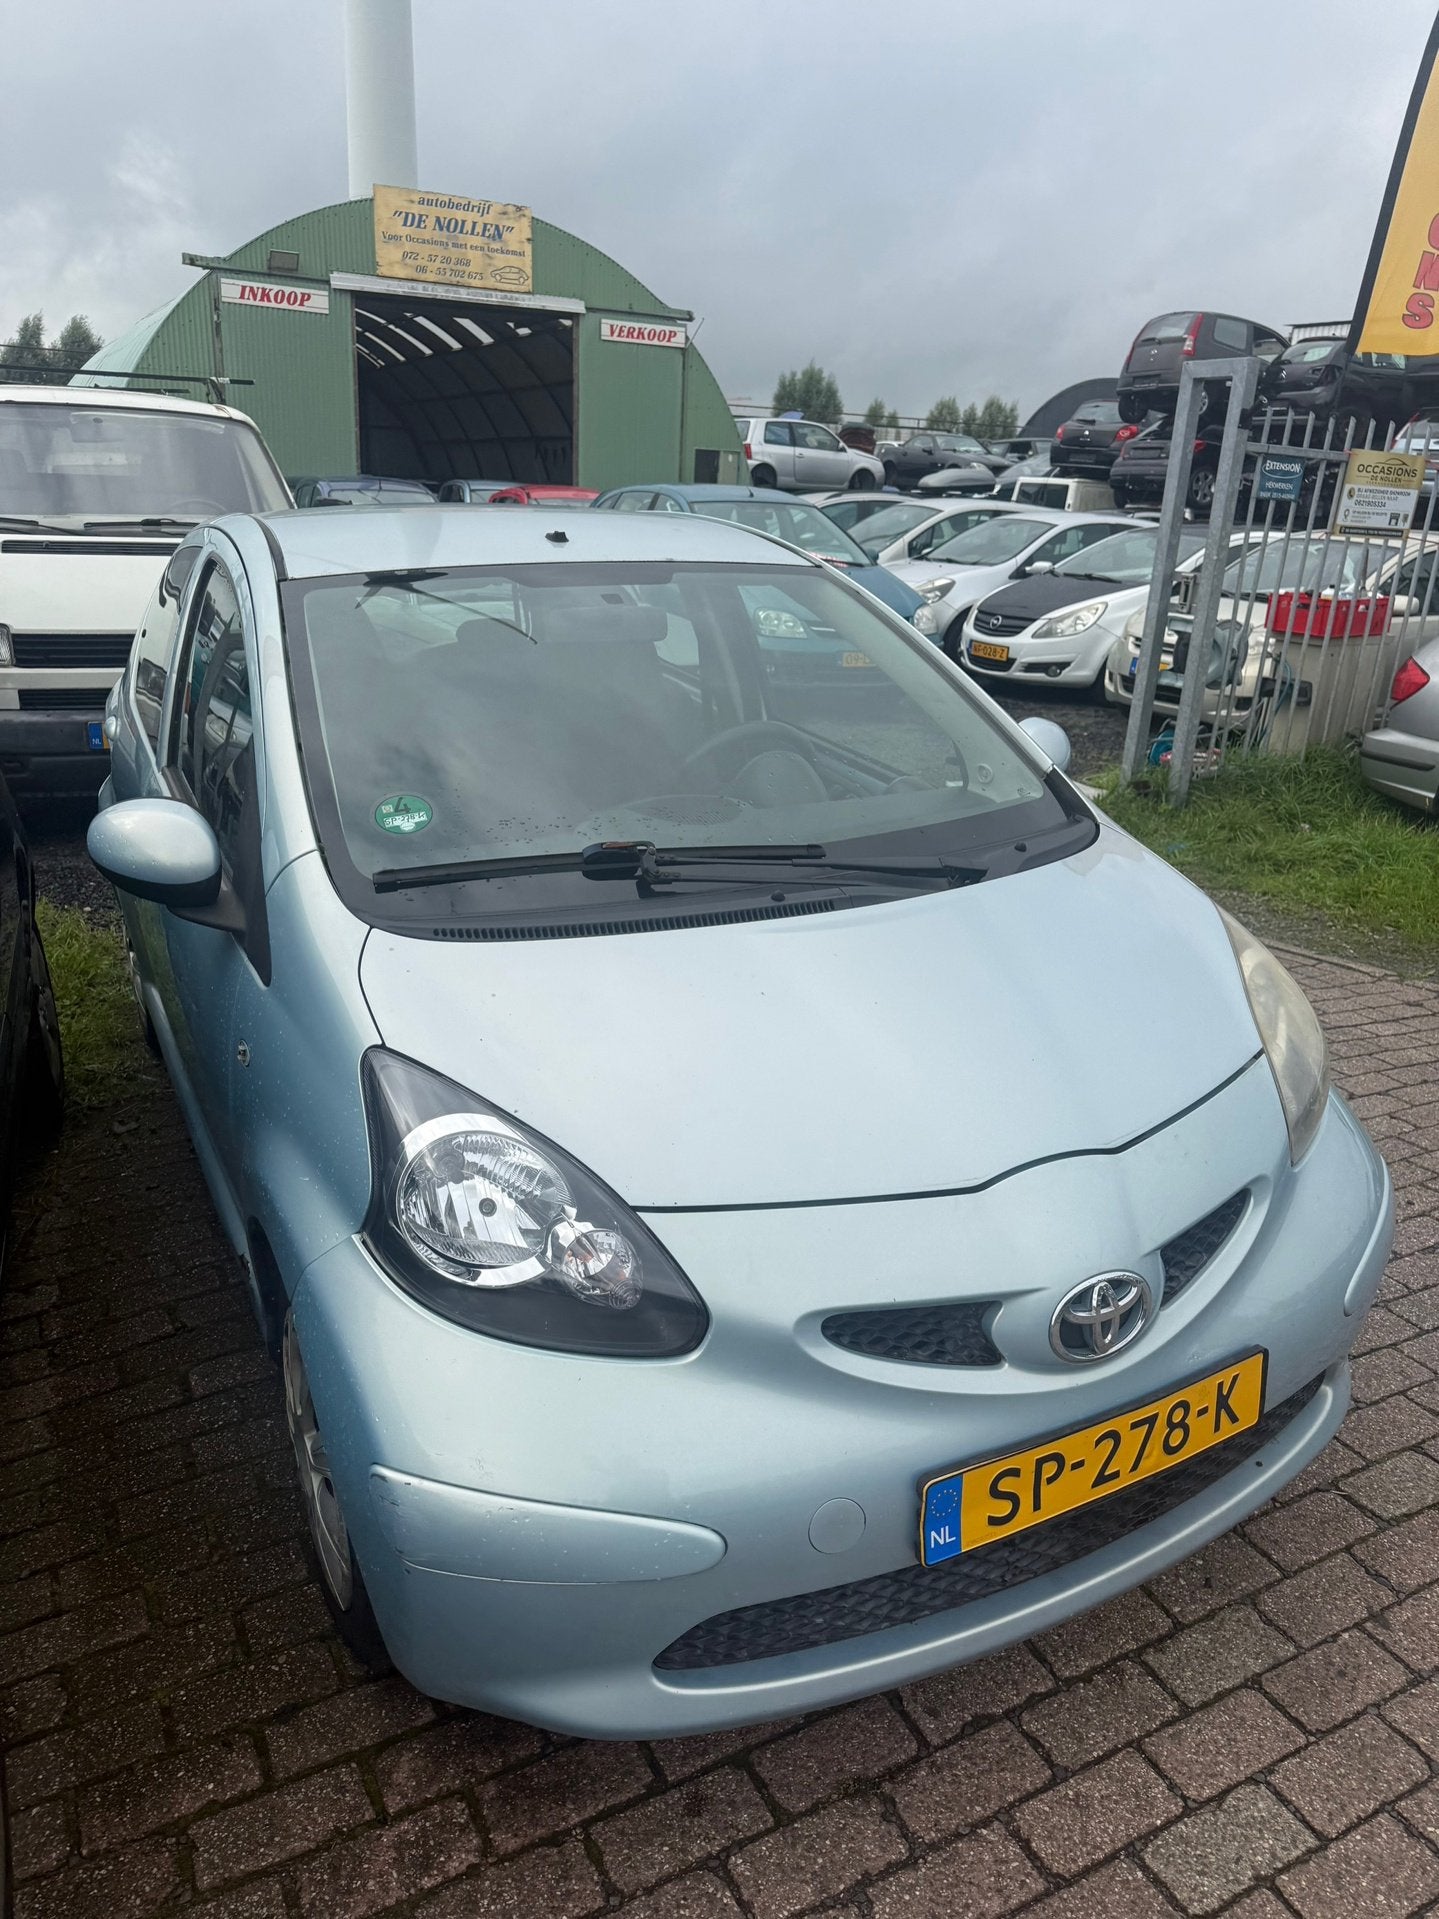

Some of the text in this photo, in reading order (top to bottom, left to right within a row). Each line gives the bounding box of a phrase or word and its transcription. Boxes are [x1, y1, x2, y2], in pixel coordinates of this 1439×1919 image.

[417, 196, 493, 217] autobedrijf
[405, 234, 450, 248] Occasions
[451, 241, 469, 250] met
[469, 244, 485, 252] een
[487, 245, 526, 258] toekomst
[402, 250, 418, 261] 072
[427, 253, 440, 263] 57
[440, 254, 451, 265] 20
[453, 257, 472, 268] 368
[415, 264, 428, 274] 06
[239, 285, 312, 307] INKOOP
[609, 323, 677, 343] VERKOOP
[1265, 460, 1301, 474] EXTENSION
[1357, 463, 1418, 478] OCCASIONS
[1380, 475, 1402, 483] NOLLEN
[987, 1372, 1240, 1527] SP-278-K
[930, 1525, 957, 1549] NL
